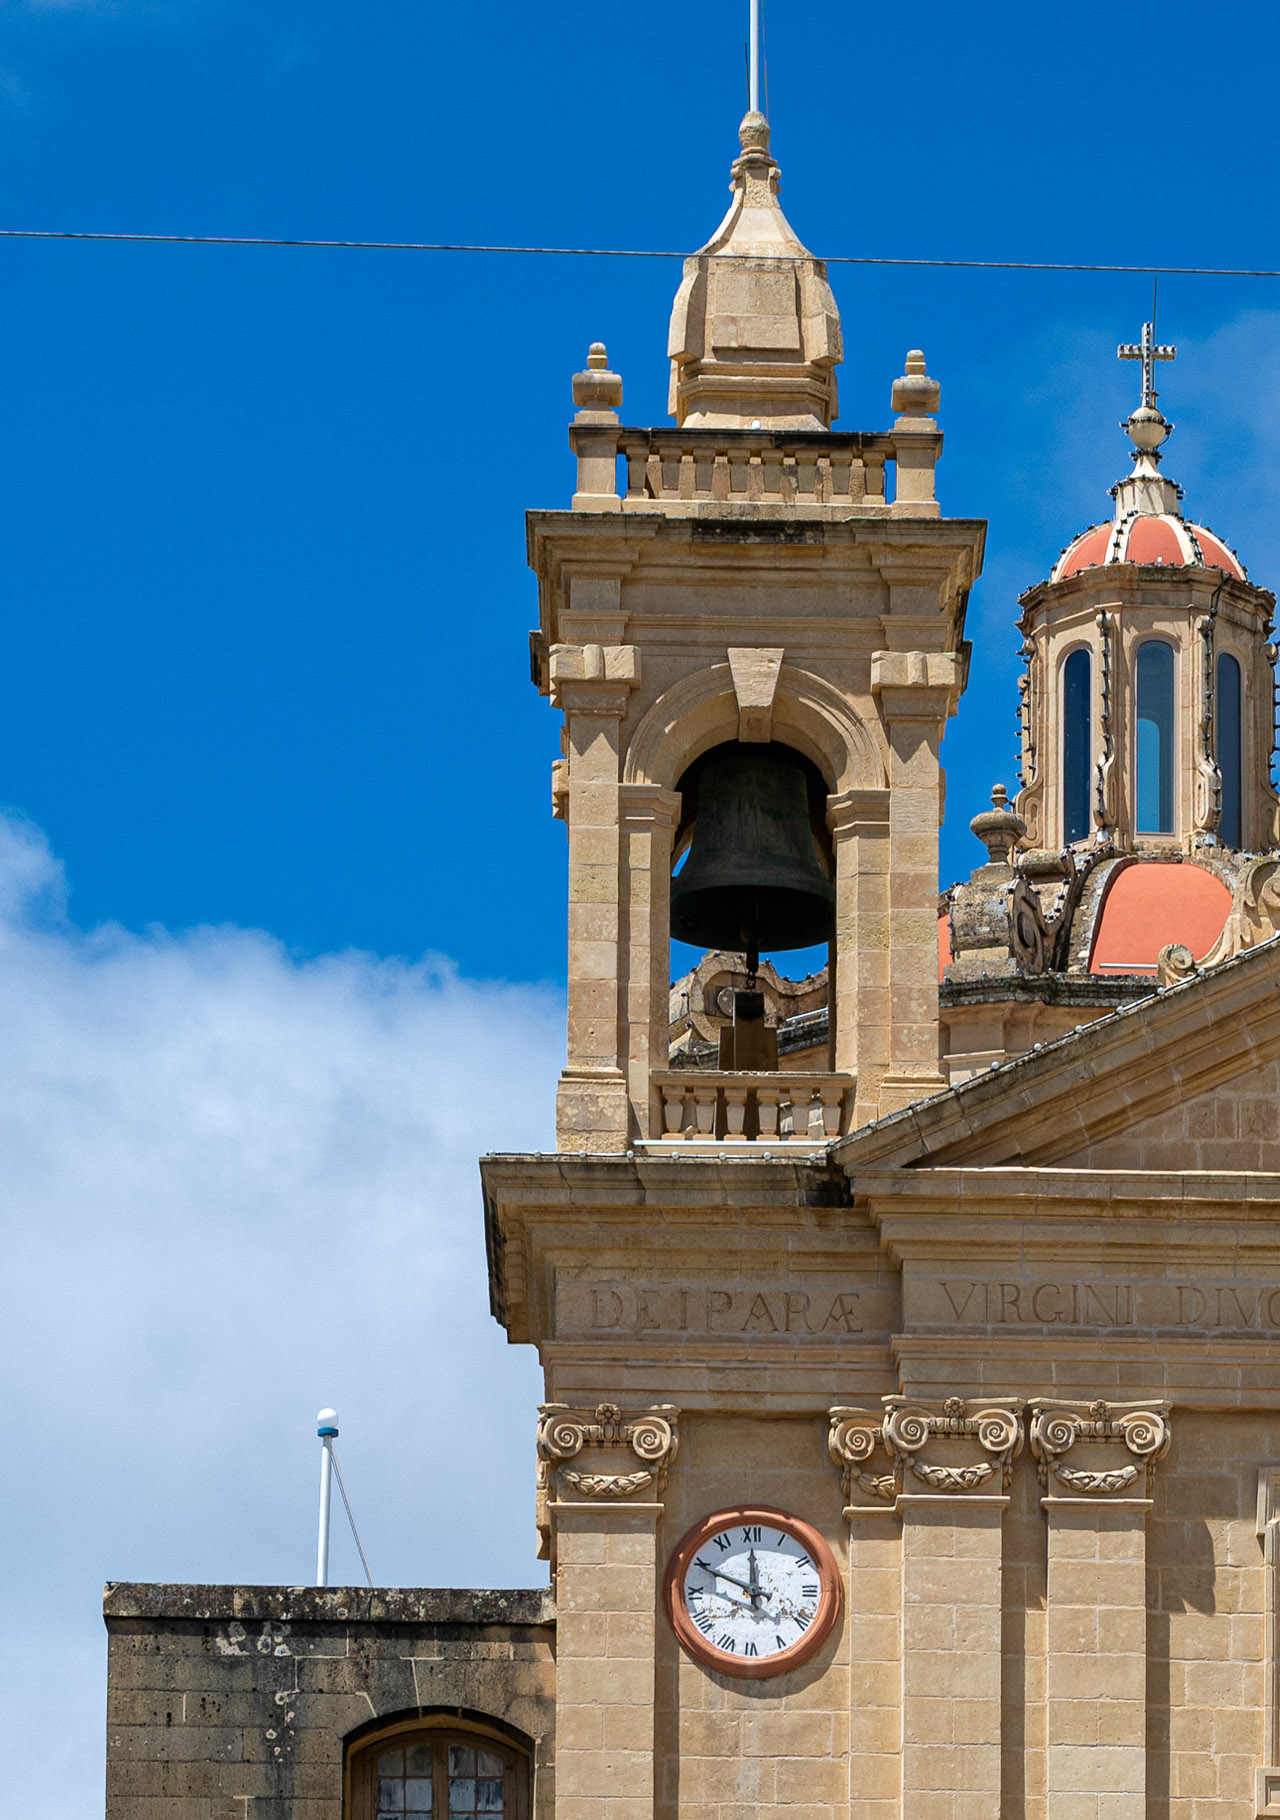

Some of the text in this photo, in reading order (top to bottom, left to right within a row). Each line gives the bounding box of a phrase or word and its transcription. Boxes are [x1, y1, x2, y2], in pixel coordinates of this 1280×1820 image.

[939, 1282, 1134, 1325] VIRGINI
[713, 1533, 732, 1551] XI
[743, 1527, 761, 1543] XII
[777, 1534, 785, 1546] I
[694, 1557, 711, 1568] X
[795, 1556, 810, 1568] II
[688, 1586, 703, 1600] IX
[802, 1585, 817, 1597] III
[694, 1611, 713, 1633] VIII
[717, 1634, 735, 1651] VII
[745, 1642, 758, 1656] VI
[777, 1635, 786, 1649] V
